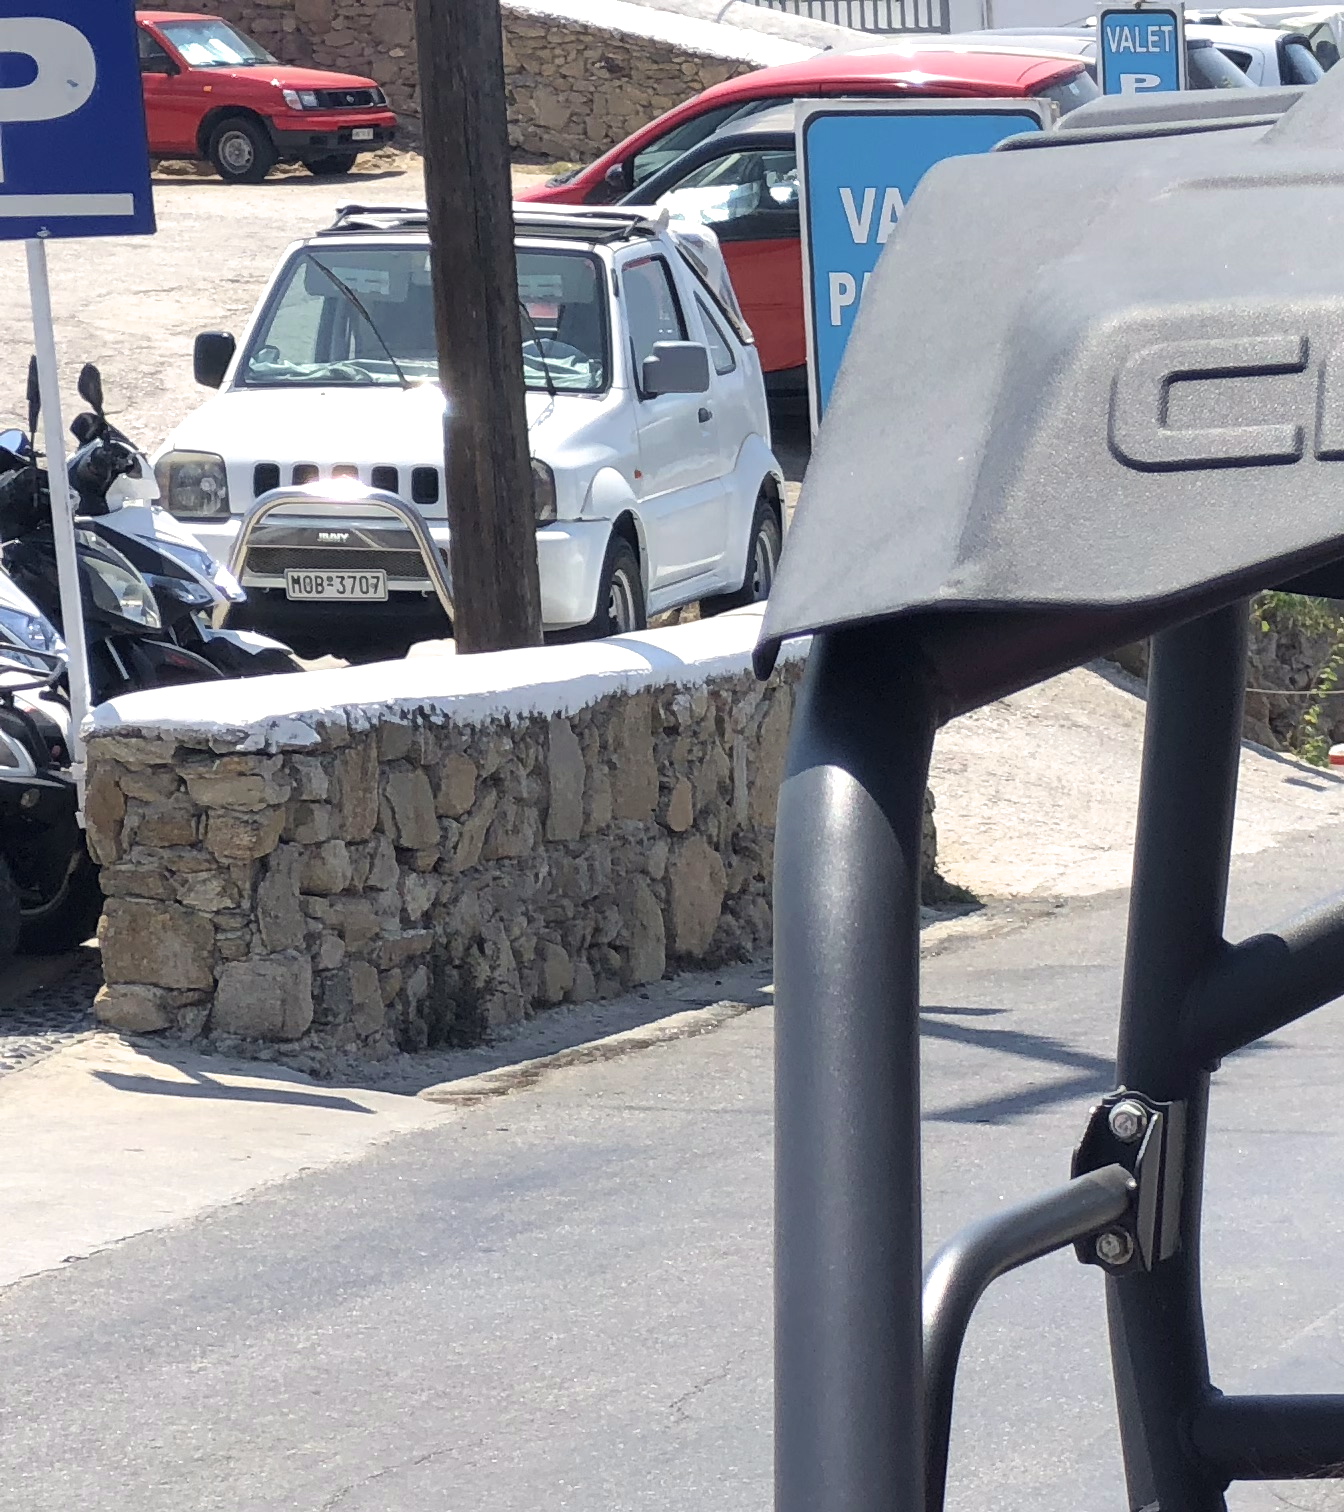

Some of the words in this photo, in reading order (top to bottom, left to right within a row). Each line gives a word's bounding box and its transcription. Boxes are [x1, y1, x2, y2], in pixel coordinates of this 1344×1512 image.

[1106, 25, 1174, 53] VALET
[1119, 73, 1161, 96] P
[0, 17, 96, 183] P
